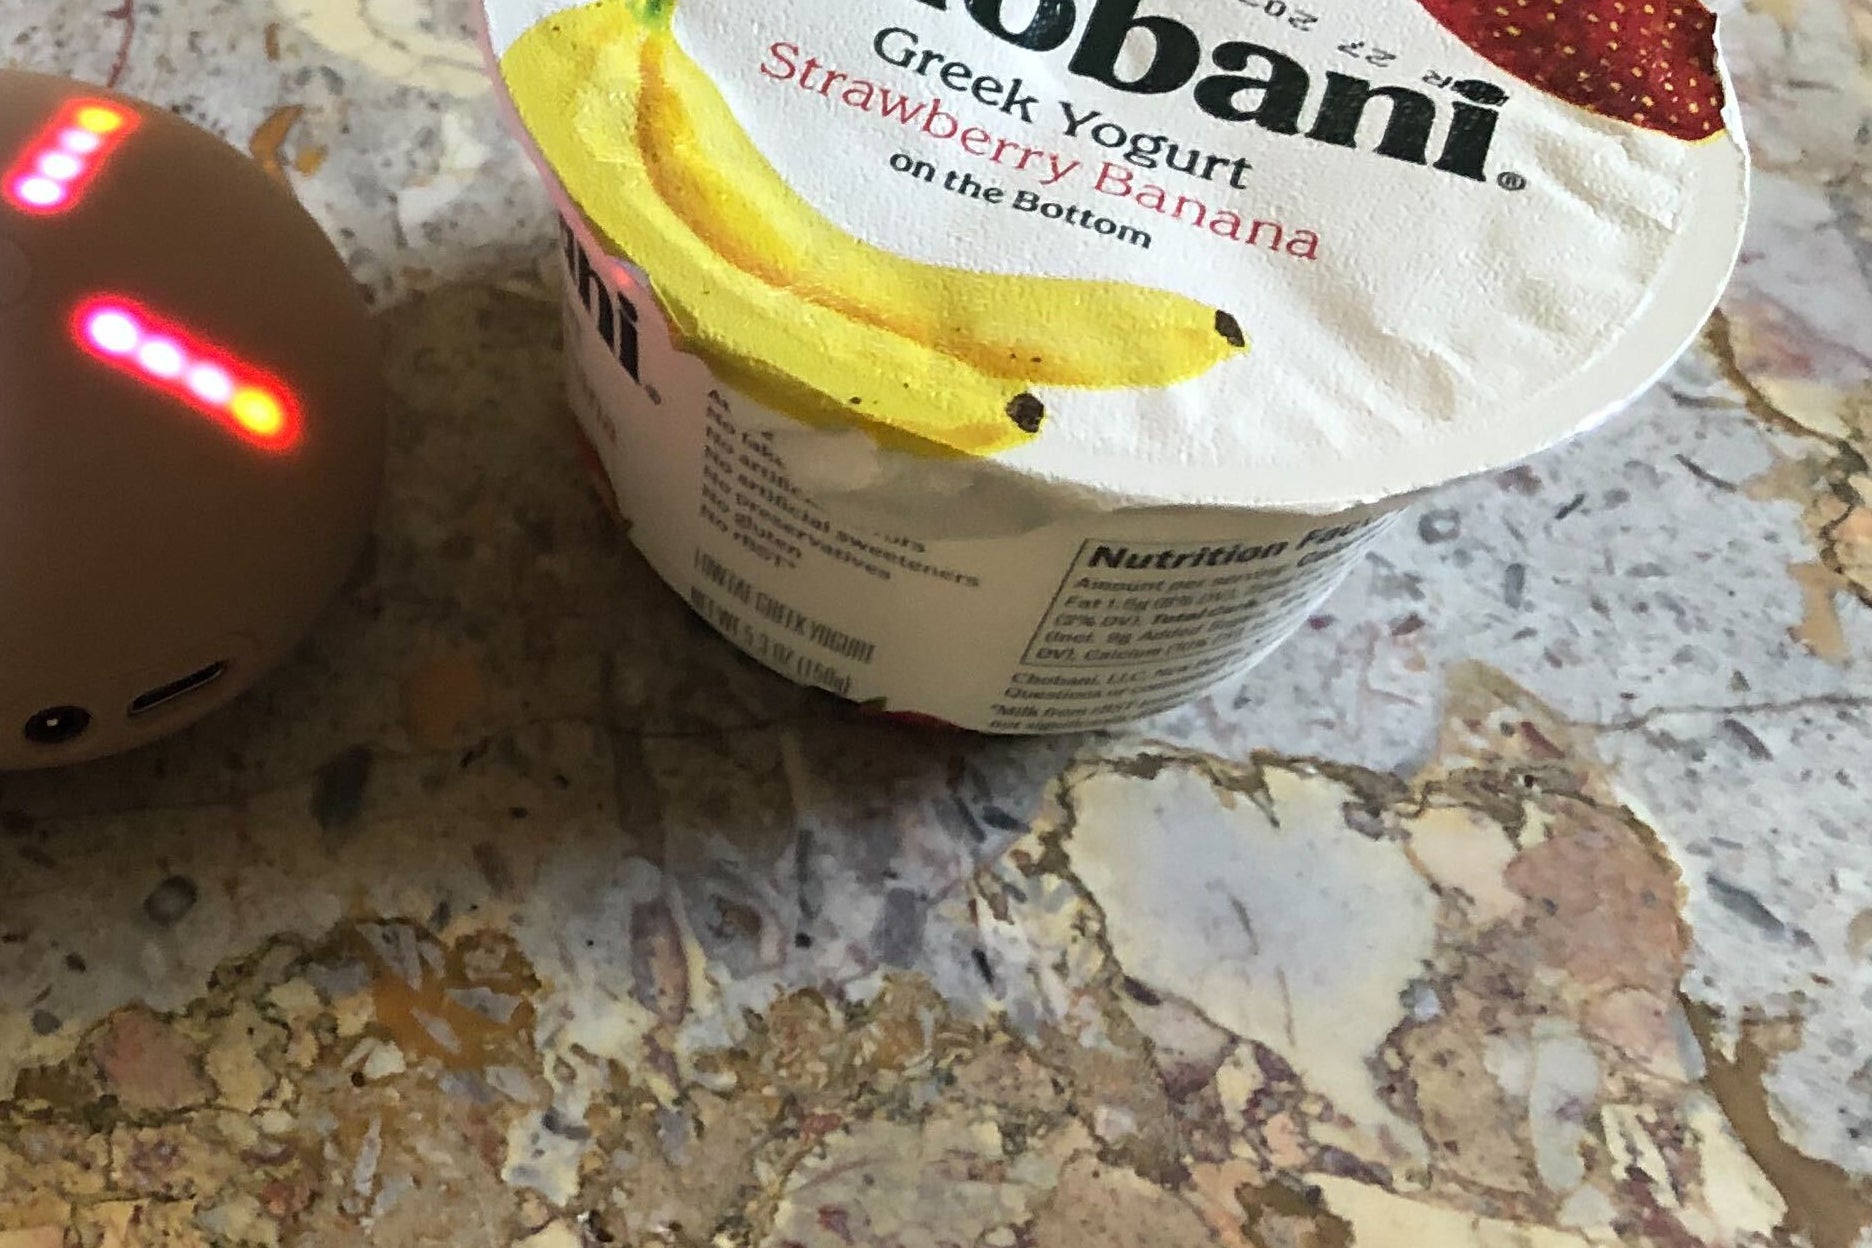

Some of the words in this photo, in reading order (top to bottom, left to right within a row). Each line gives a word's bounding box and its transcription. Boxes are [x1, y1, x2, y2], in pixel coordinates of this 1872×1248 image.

[760, 41, 1081, 187] Strawberry
[1094, 160, 1321, 261] Banana
[873, 26, 1039, 124] Greek
[1058, 100, 1254, 190] Yogurt
[889, 151, 936, 183] on
[943, 168, 1005, 205] the
[1012, 189, 1154, 250] Bottom
[1088, 541, 1289, 570] Nutrition
